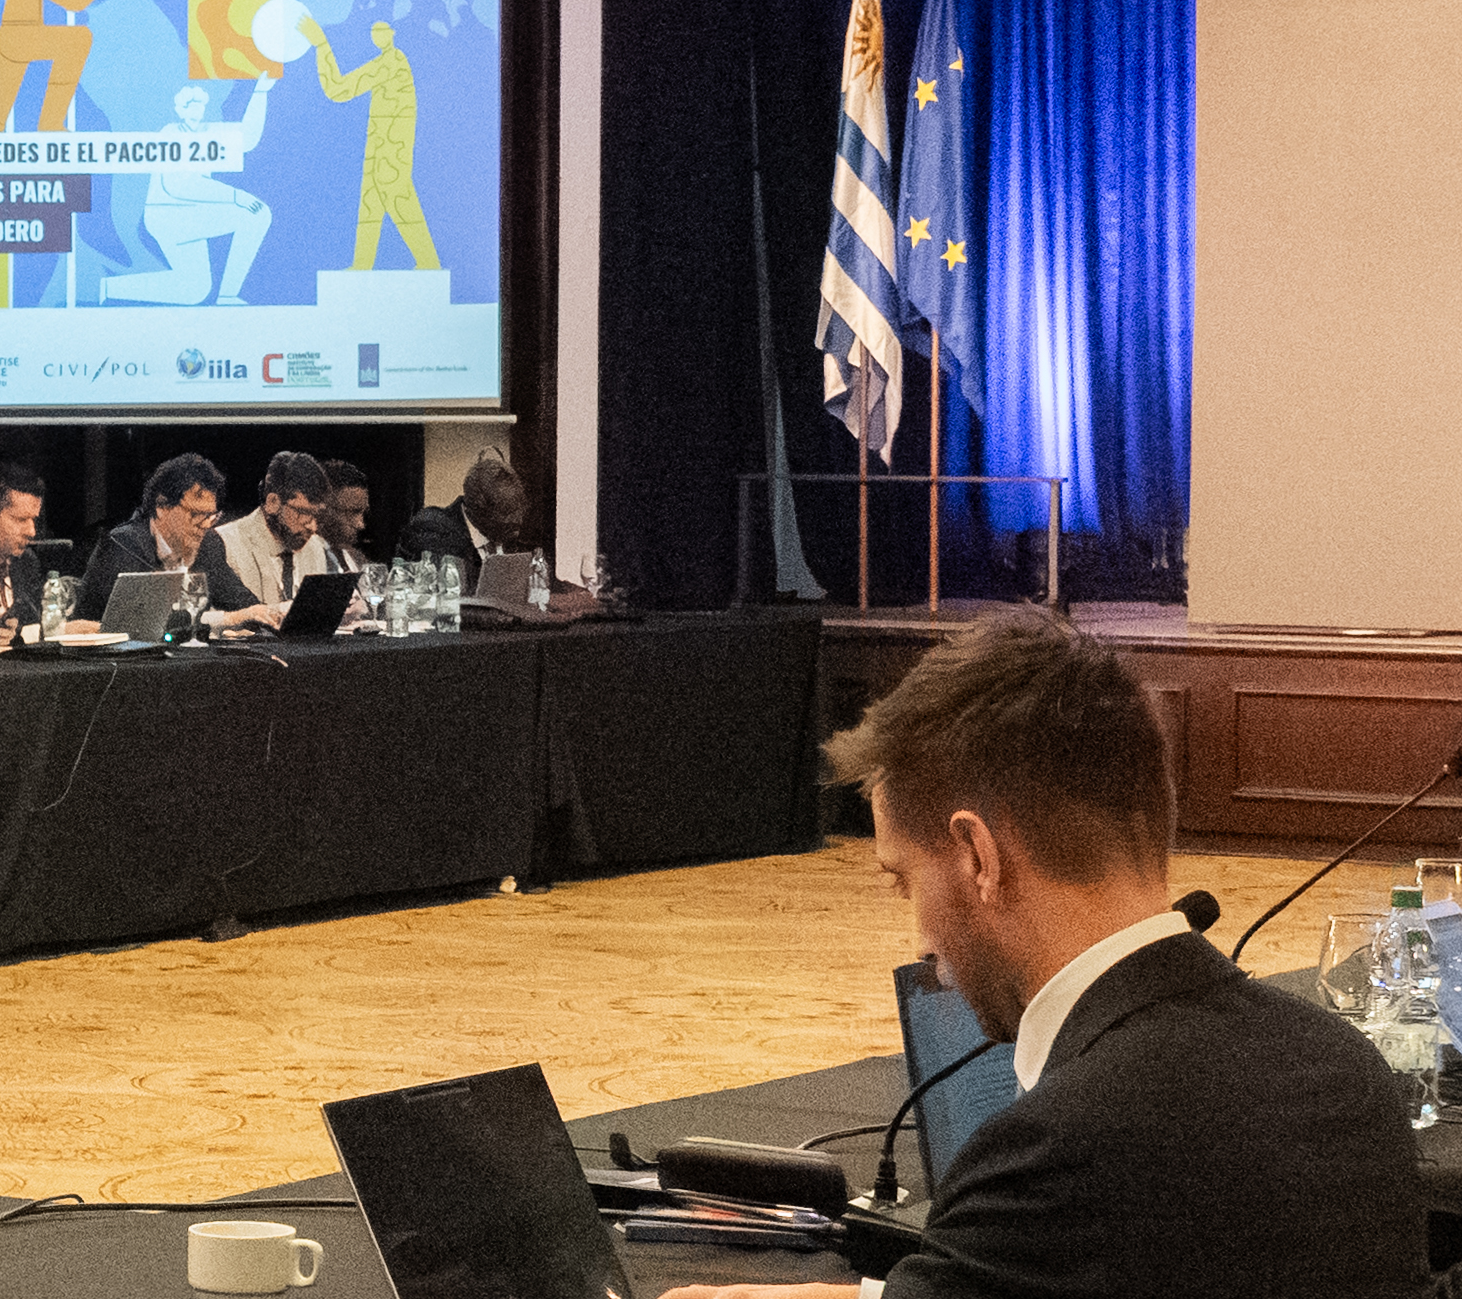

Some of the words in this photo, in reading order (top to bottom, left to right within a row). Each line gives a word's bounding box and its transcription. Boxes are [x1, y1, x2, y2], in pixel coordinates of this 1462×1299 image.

[46, 142, 70, 163] DE
[78, 142, 97, 162] EL
[105, 141, 182, 162] PACCTO
[189, 140, 226, 162] 2.0:
[10, 180, 66, 203] PARA
[208, 359, 248, 379] iila
